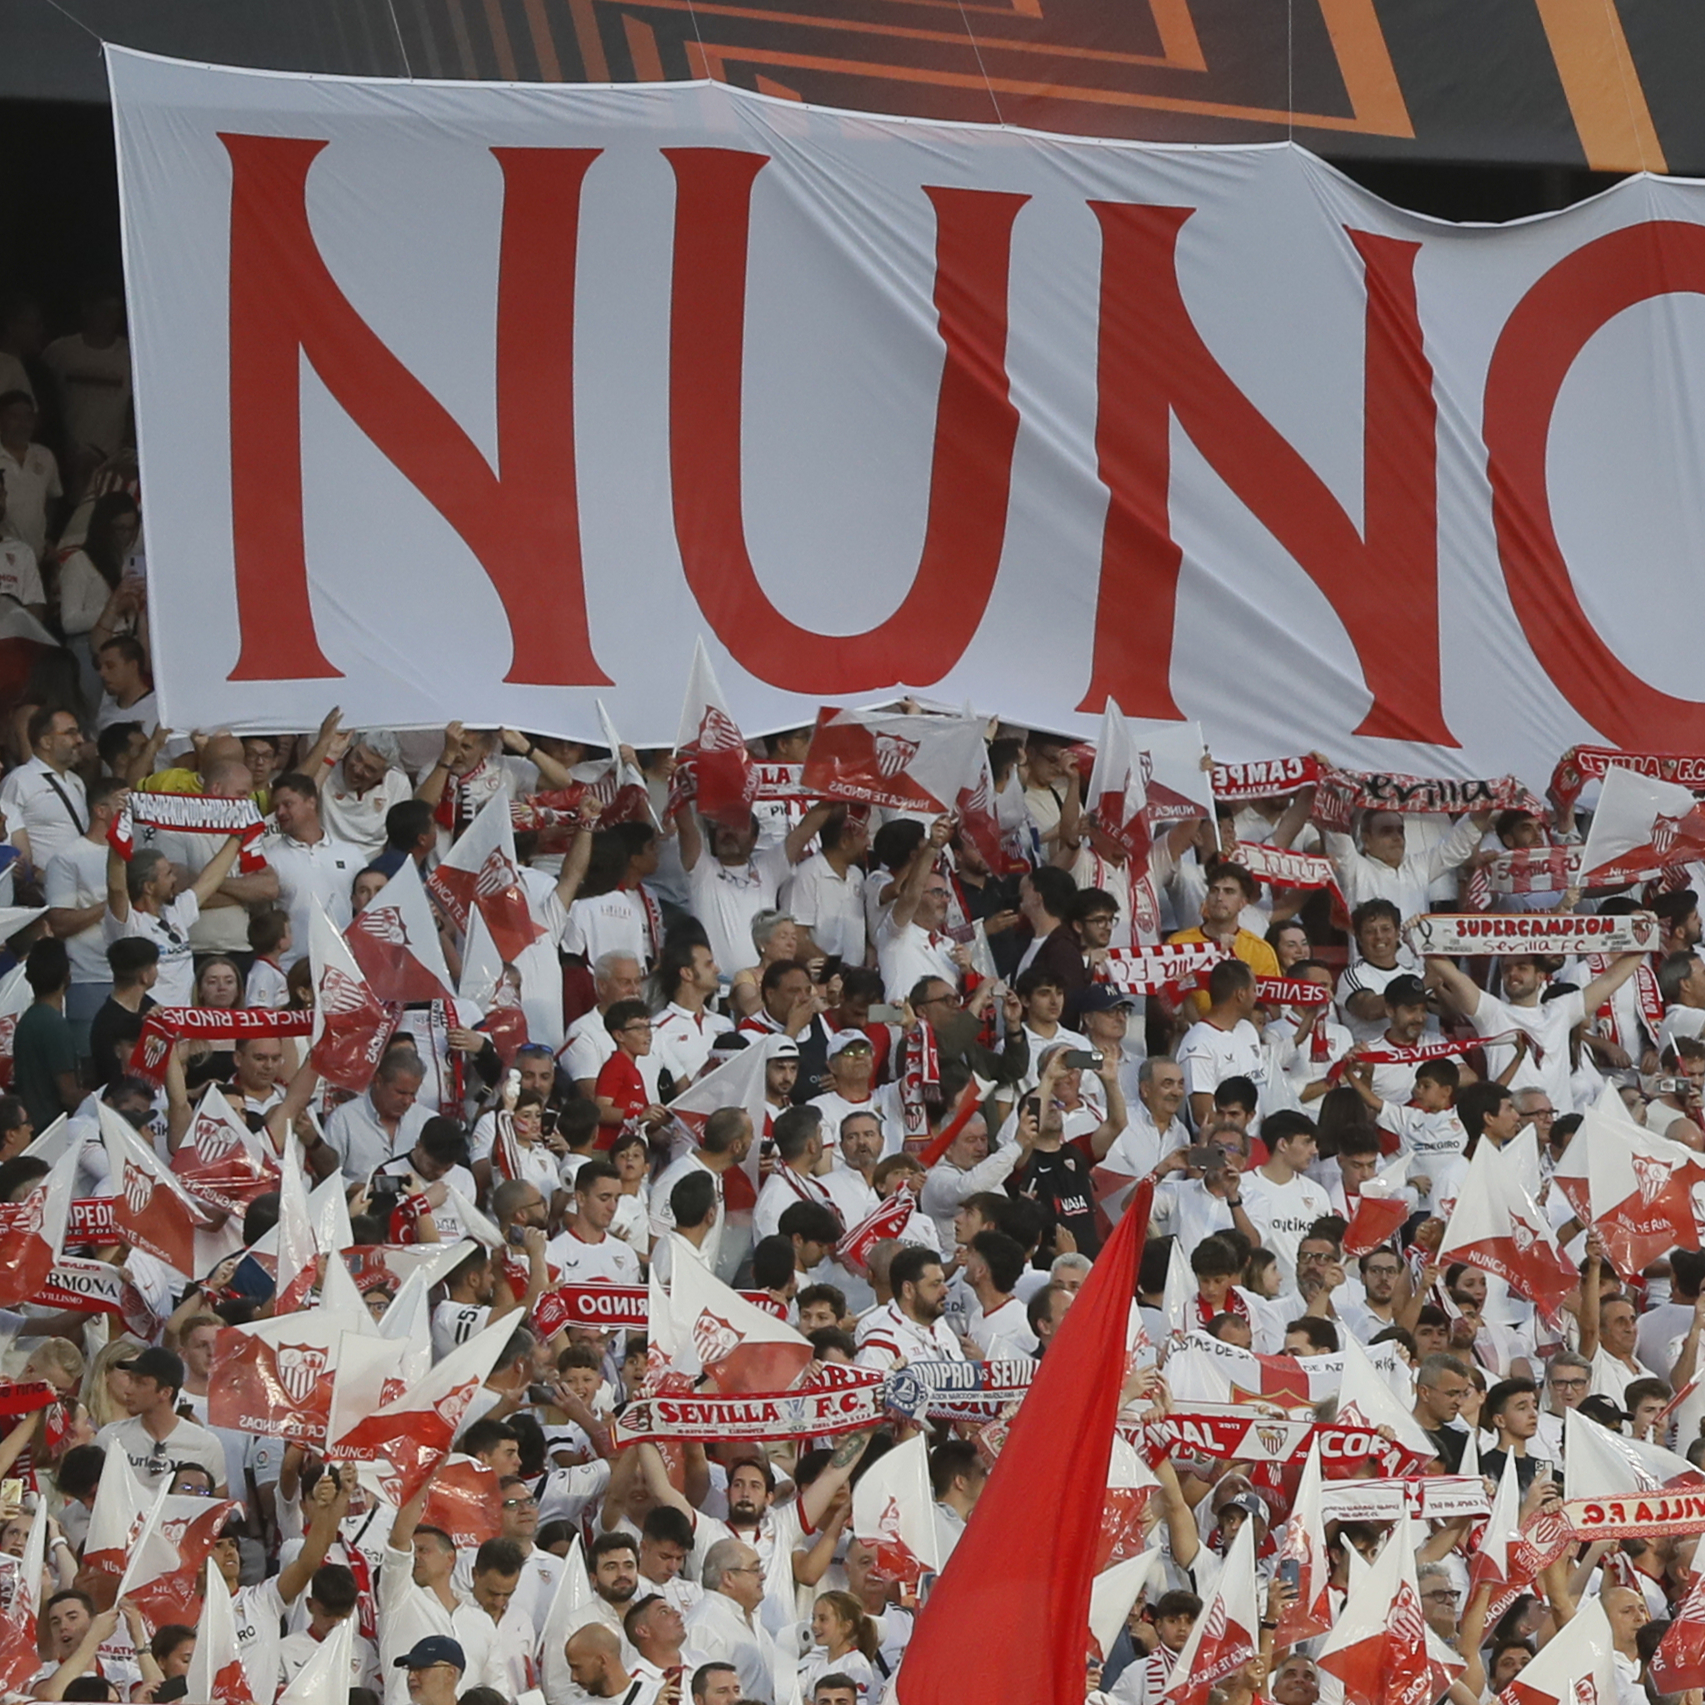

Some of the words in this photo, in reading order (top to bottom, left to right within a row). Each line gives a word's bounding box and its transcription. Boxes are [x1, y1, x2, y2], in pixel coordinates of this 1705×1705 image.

[1363, 776, 1496, 807] evilla
[1455, 918, 1615, 937] SUPERCAMPEON
[1483, 938, 1553, 954] Sevilla
[1387, 1039, 1462, 1061] SEVILLA
[1468, 1250, 1507, 1274] NUNCA
[45, 1273, 118, 1298] RMONA
[657, 1401, 778, 1425] SEVILLA
[814, 1391, 867, 1417] F.C.
[332, 1445, 375, 1460] NUNCA
